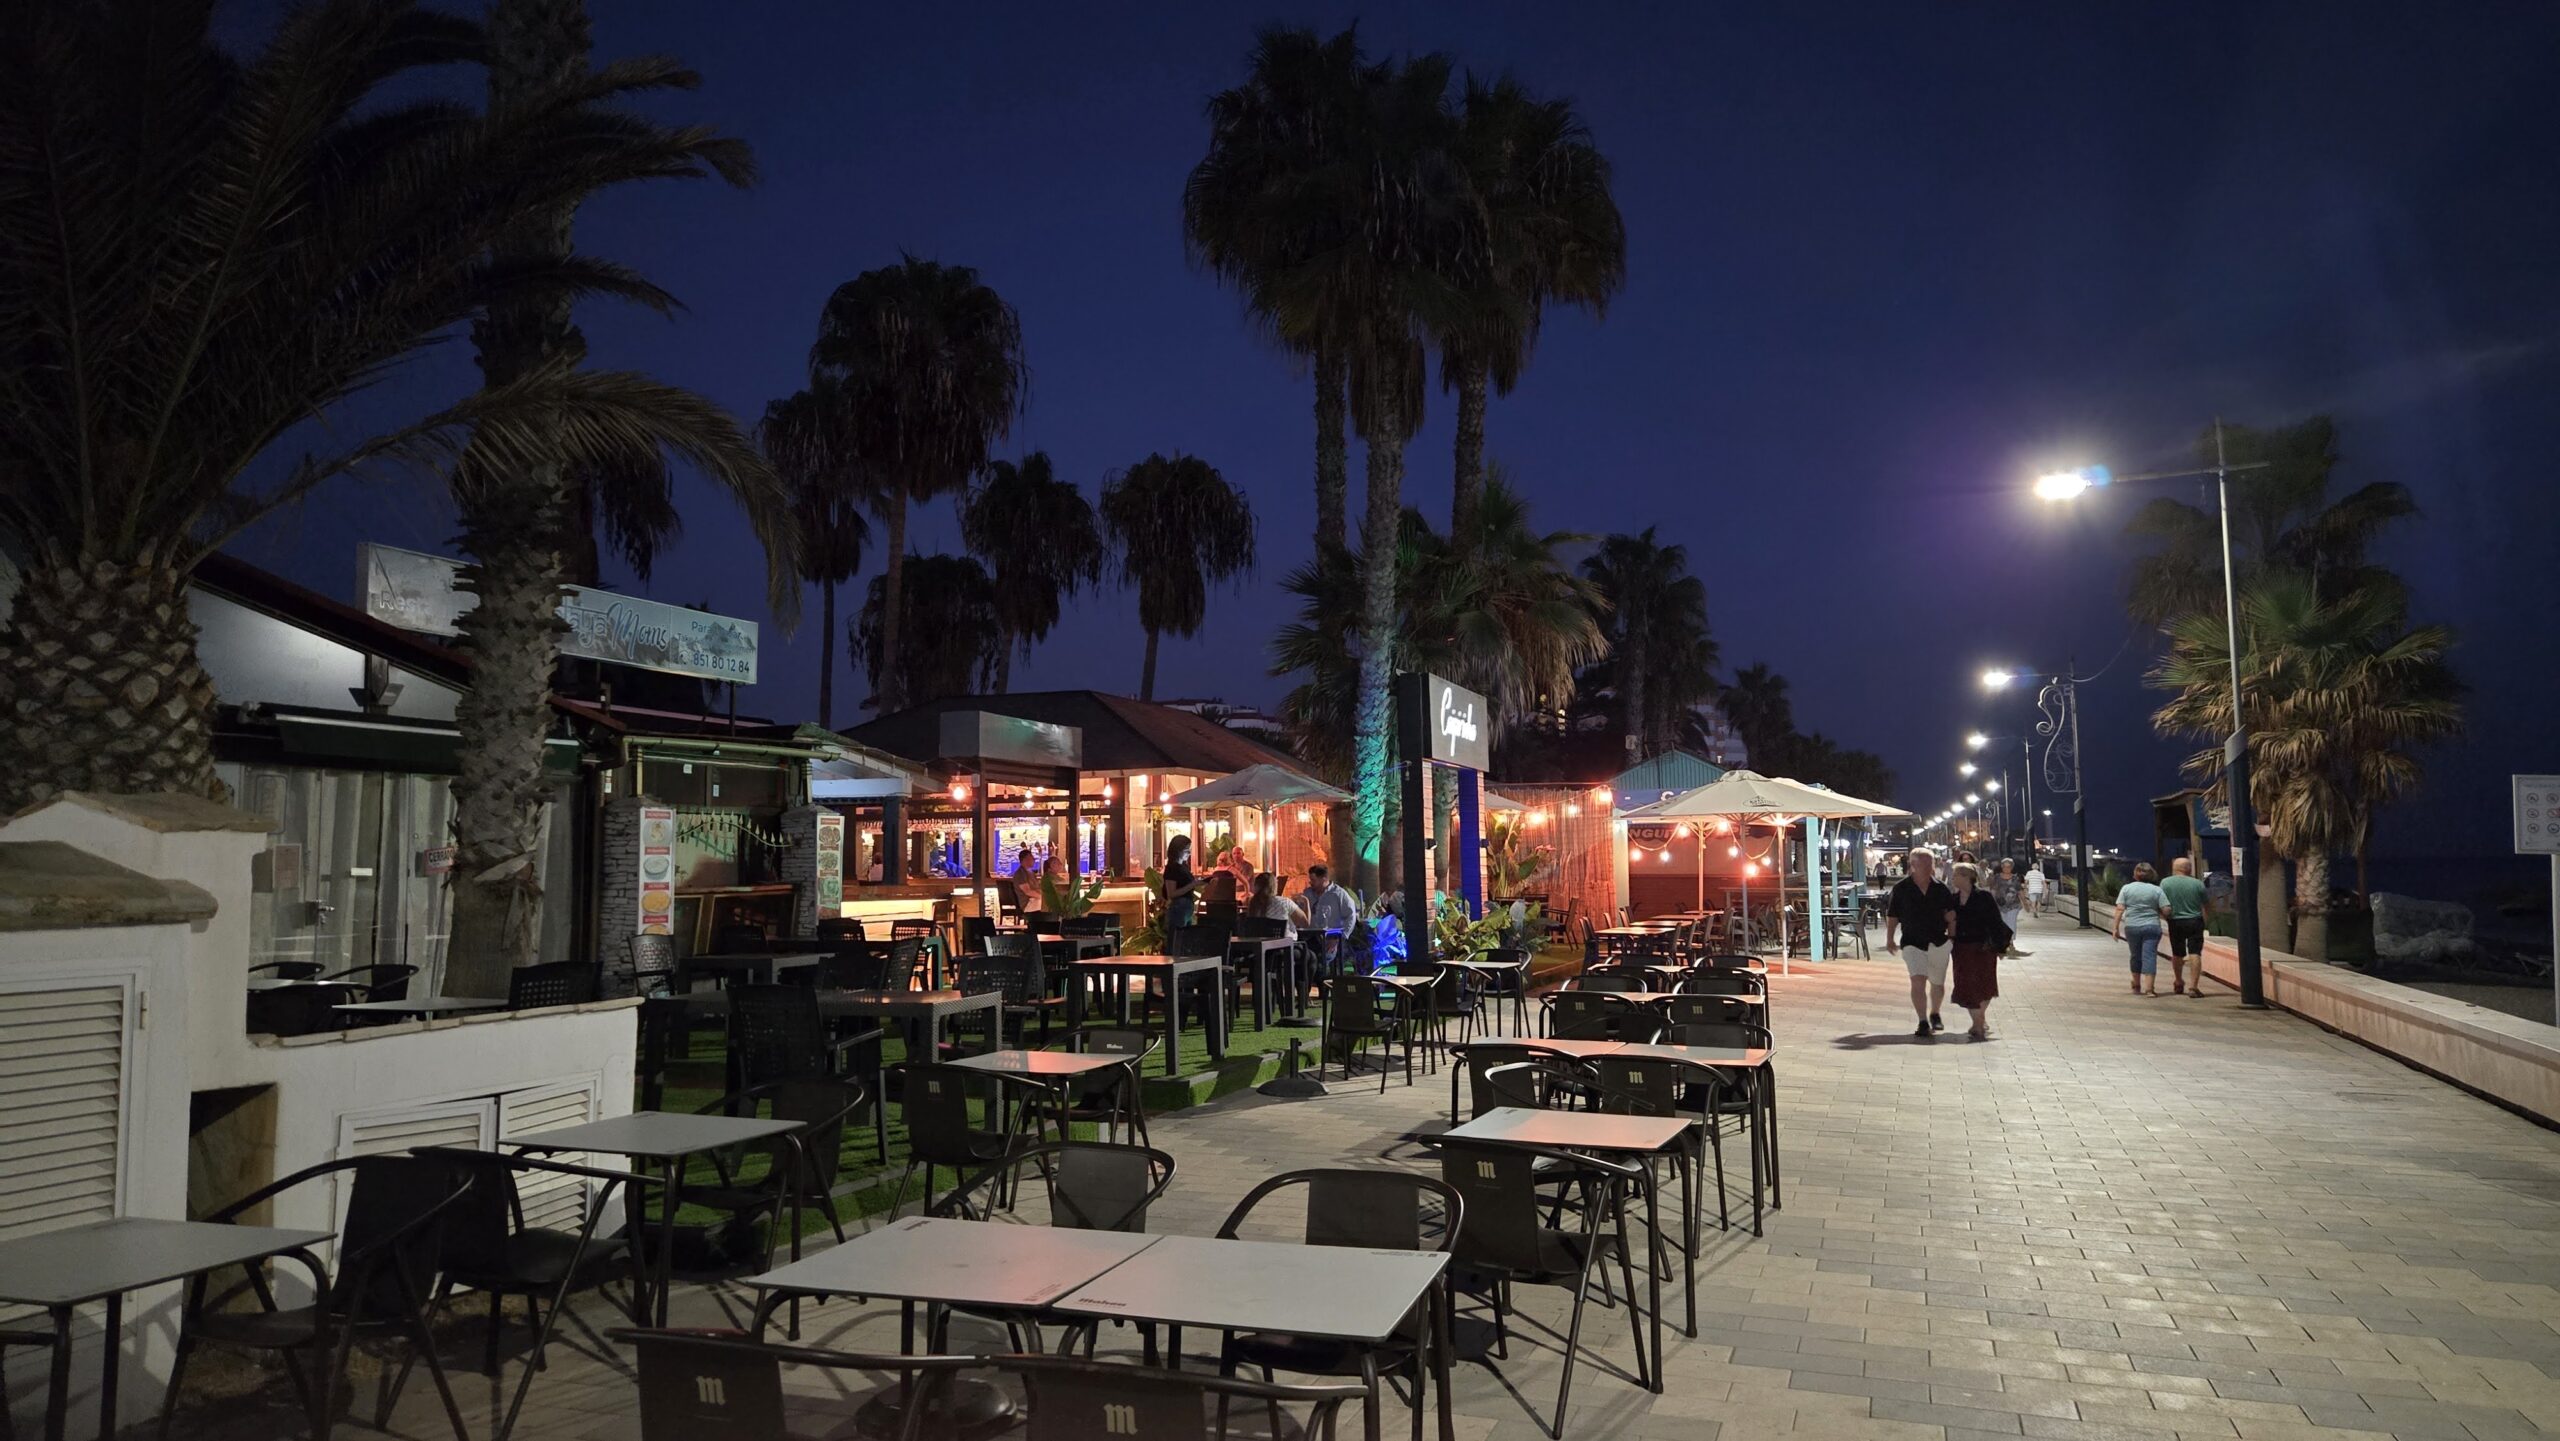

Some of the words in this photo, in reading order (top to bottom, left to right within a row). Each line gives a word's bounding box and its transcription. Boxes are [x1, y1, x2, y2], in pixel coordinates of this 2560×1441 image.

[712, 656, 724, 670] 80
[727, 658, 736, 672] 12
[738, 660, 750, 674] 84
